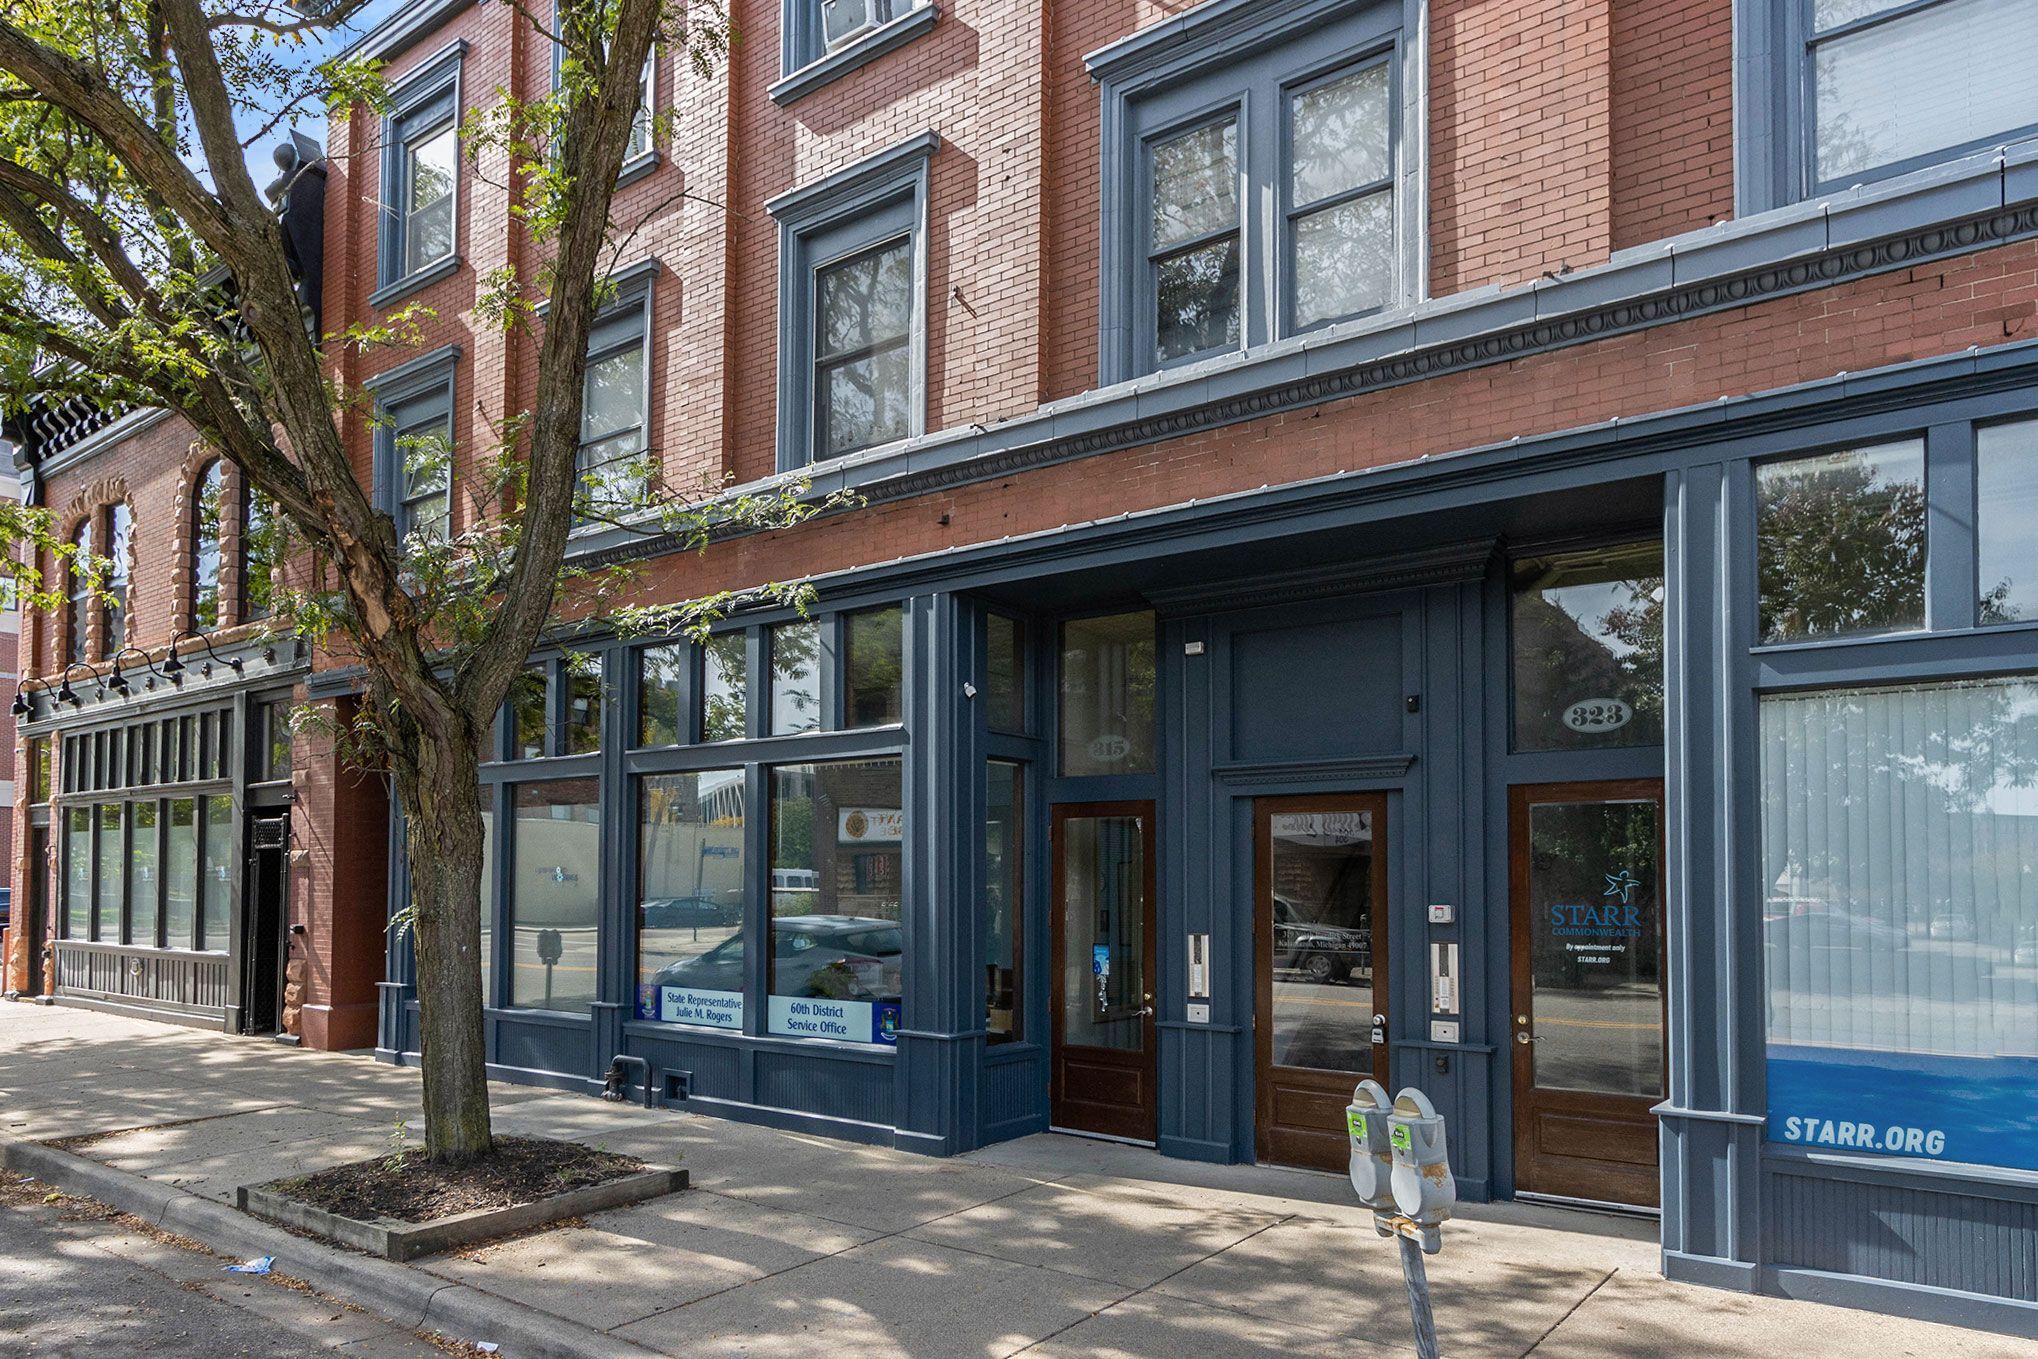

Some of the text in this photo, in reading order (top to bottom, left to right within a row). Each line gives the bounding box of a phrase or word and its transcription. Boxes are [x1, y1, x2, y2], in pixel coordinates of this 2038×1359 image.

[1571, 704, 1623, 726] 323
[1092, 741, 1125, 756] 315
[1551, 904, 1641, 926] STARR
[1342, 932, 1362, 941] Street
[1551, 927, 1641, 937] COMMONWEALTH
[1317, 941, 1347, 951] Michigan
[1565, 943, 1626, 952] By appointment only
[667, 992, 742, 1010] State Representative
[676, 1006, 693, 1018] Julie
[706, 1009, 732, 1023] Rogers
[790, 1002, 844, 1018] 60th District
[787, 1018, 847, 1035] Service Office
[1784, 1116, 1946, 1155] STARR.ORG
